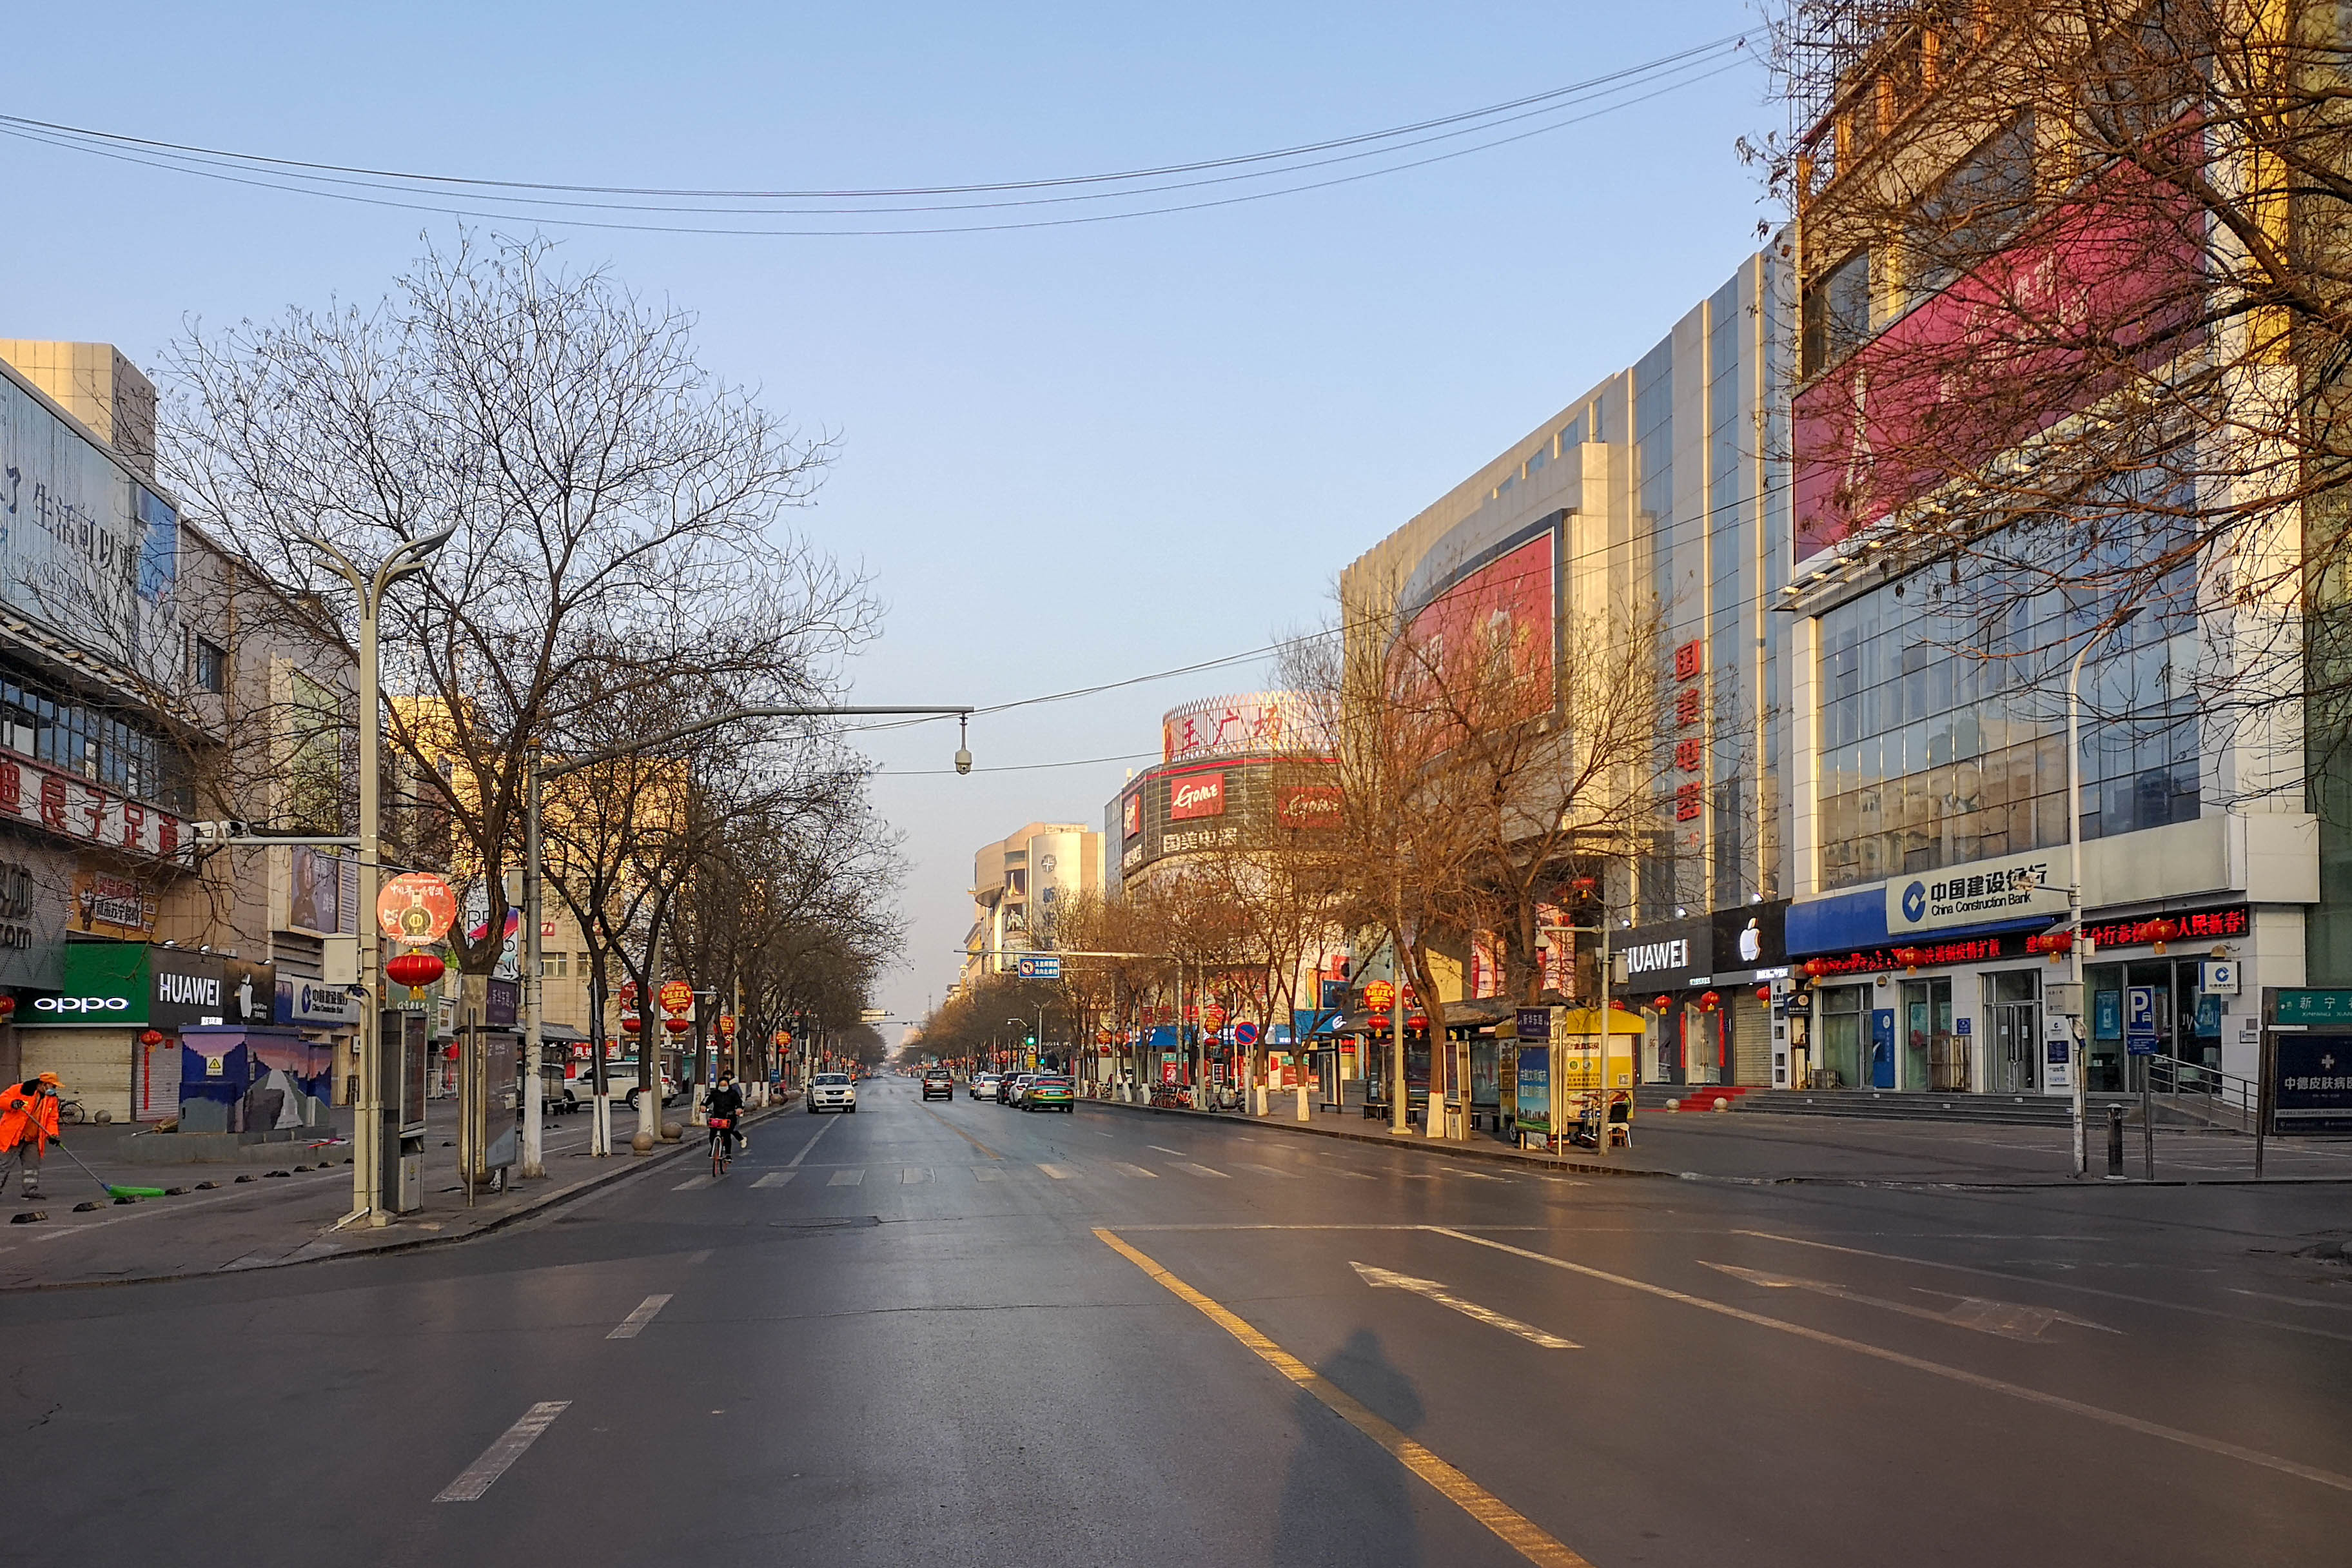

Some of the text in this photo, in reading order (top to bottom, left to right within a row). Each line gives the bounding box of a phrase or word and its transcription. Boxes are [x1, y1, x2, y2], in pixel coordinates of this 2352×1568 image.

[1676, 638, 1701, 822] 国美电器
[1163, 827, 1237, 852] 国美电器
[1932, 892, 2032, 916] China Construction Bank
[1622, 939, 1690, 974] HUAWEI
[160, 973, 219, 1006] HUAWEI
[2130, 991, 2148, 1023] P
